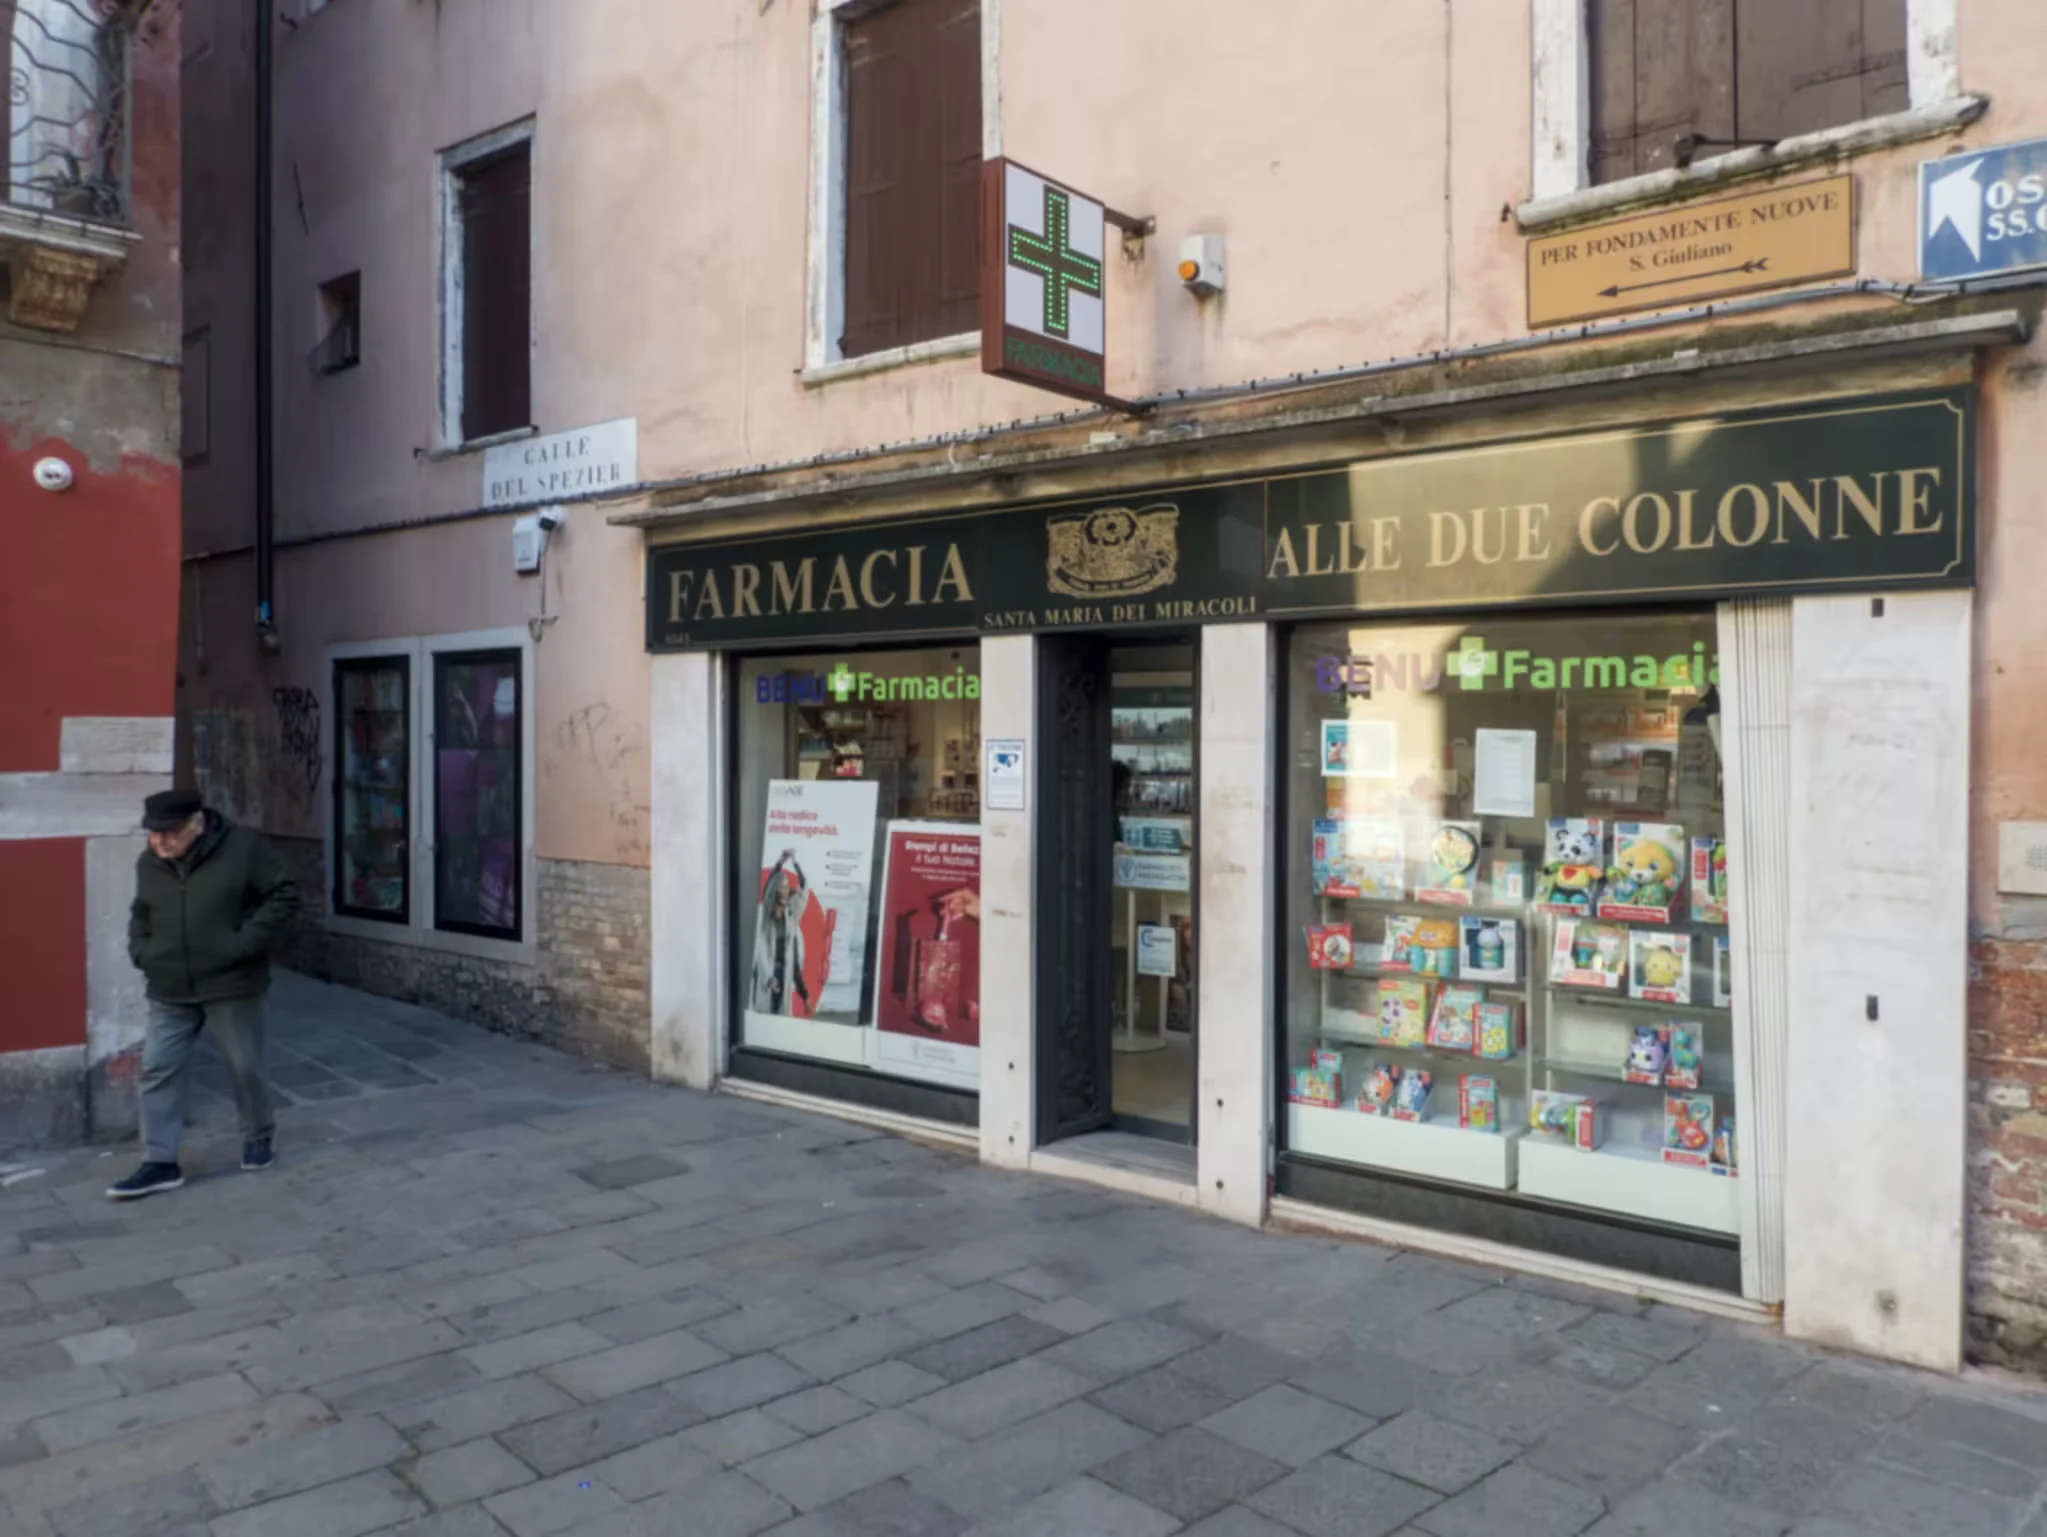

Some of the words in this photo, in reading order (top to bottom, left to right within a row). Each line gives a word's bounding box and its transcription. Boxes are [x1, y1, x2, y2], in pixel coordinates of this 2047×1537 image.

[1541, 244, 1579, 266] PER
[1586, 210, 1741, 257] FONDAMENTE
[1751, 191, 1840, 226] NUOVE
[1629, 253, 1647, 272] S.
[1651, 242, 1733, 268] Giuliano
[1005, 336, 1103, 388] FARMACIA
[524, 435, 591, 465] CALLE
[491, 477, 529, 500] DEL
[538, 461, 621, 492] SPEZIER
[1267, 516, 1401, 579] ALLE
[1426, 503, 1551, 567] DUE
[1578, 466, 1944, 557] COLONNE
[667, 543, 975, 622] FARMACIA
[984, 610, 1036, 628] SANTA
[1045, 606, 1104, 625] MARIA
[1112, 603, 1145, 622] DEI
[1155, 596, 1256, 618] MIRACOLI
[756, 672, 826, 703] BENU
[858, 665, 981, 701] Farmacia
[1315, 652, 1441, 692] BENU
